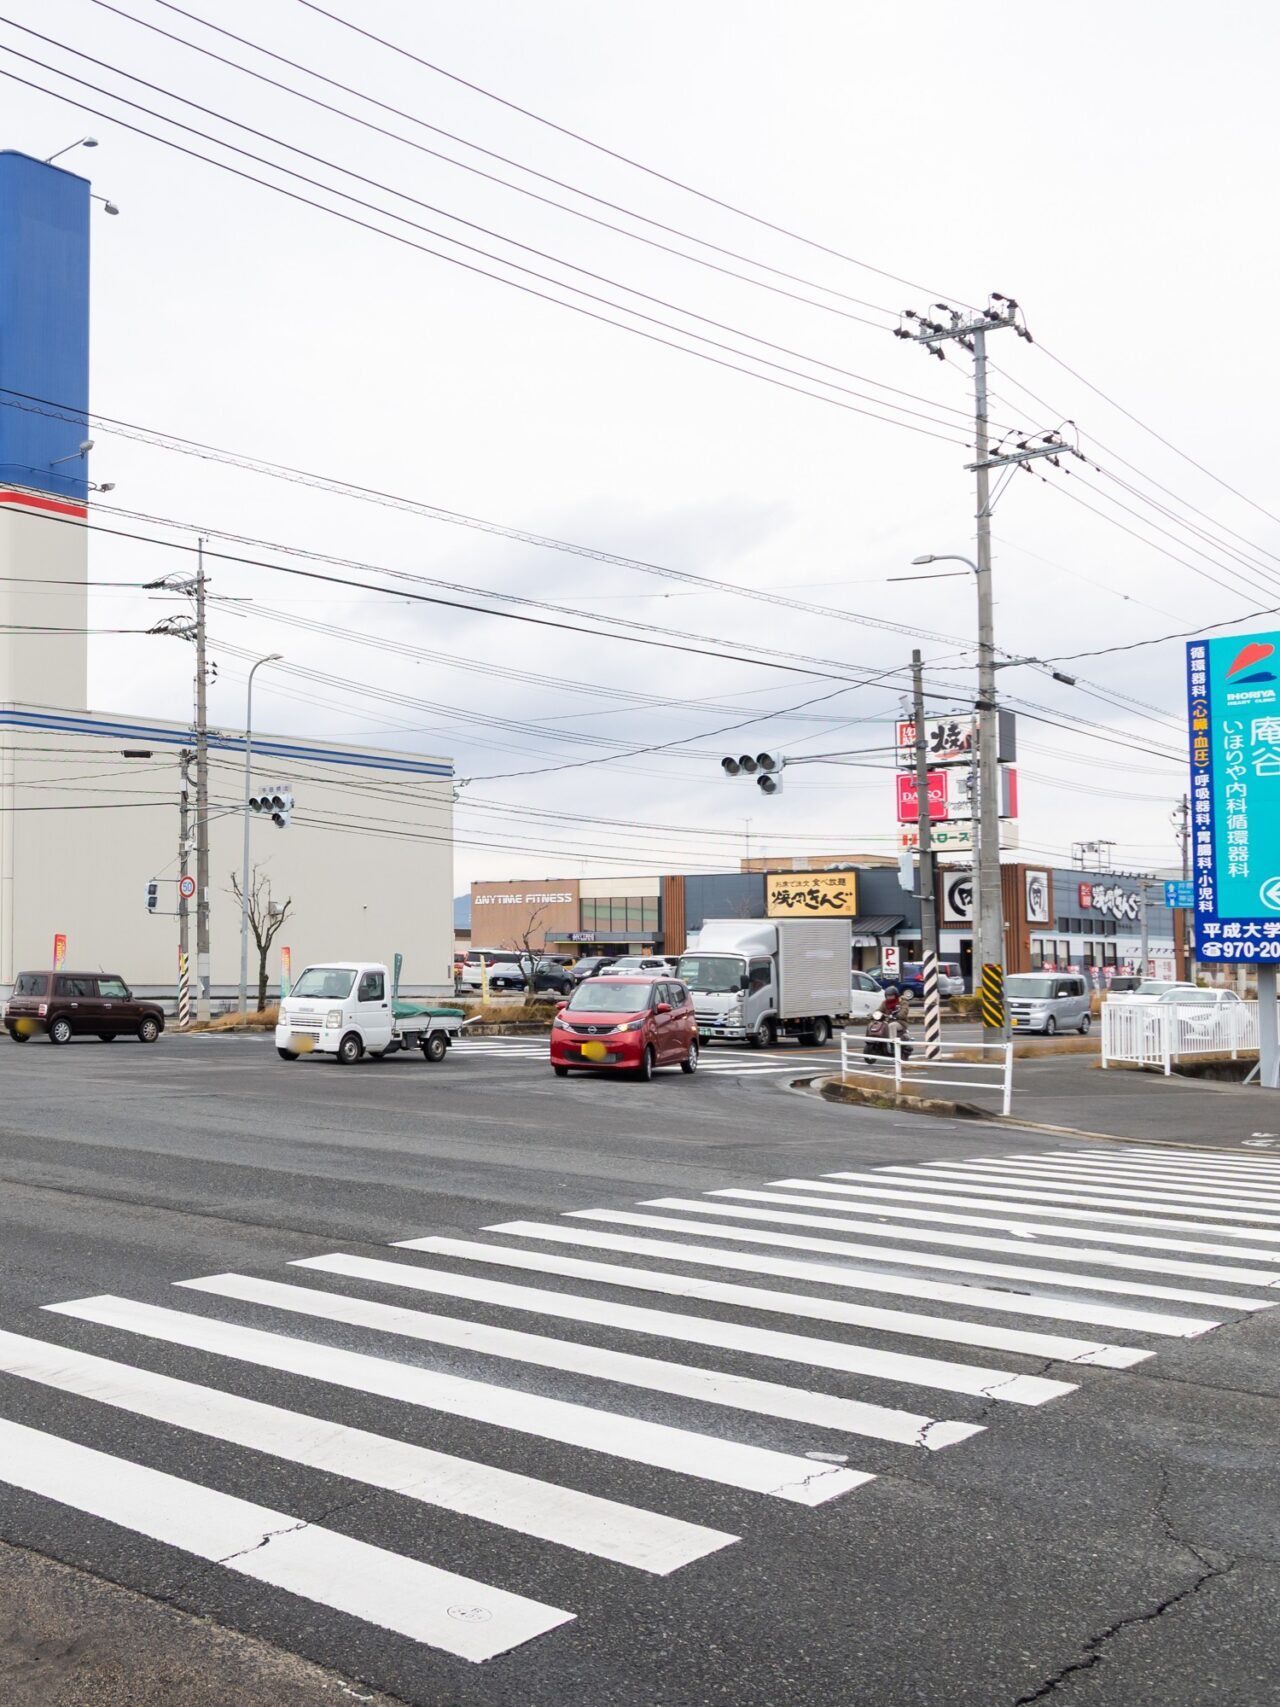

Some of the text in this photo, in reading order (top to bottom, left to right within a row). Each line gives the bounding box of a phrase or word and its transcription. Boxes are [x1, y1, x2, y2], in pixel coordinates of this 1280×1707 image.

[1226, 689, 1276, 701] IHORIYA
[903, 790, 941, 801] DASO
[1223, 720, 1249, 878] いほりや内科循環器科
[182, 881, 192, 892] 50
[475, 893, 573, 905] ANYTIME FITNESS
[772, 888, 854, 910] 焼肉きんぐ
[1203, 922, 1280, 939] 平成大学
[885, 948, 895, 959] P
[1223, 941, 1280, 958] 970-20
